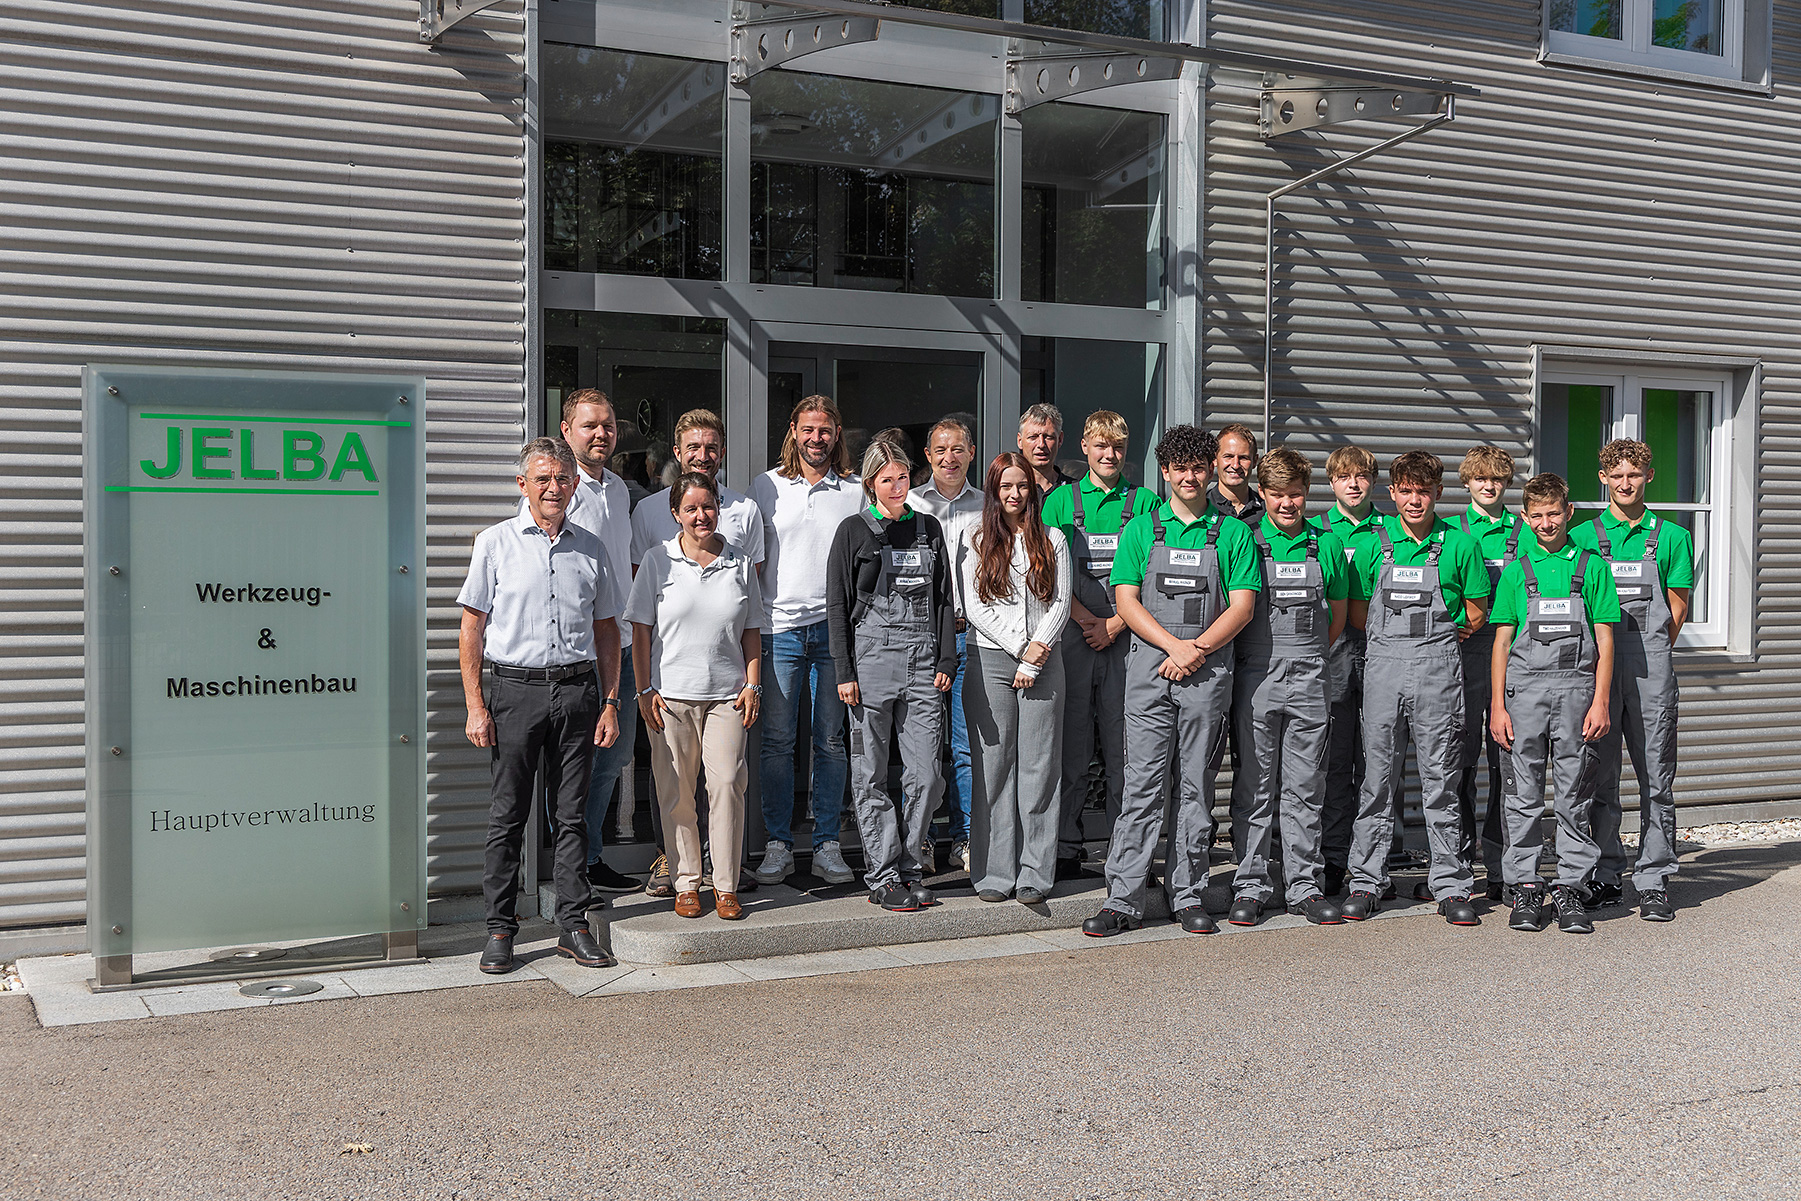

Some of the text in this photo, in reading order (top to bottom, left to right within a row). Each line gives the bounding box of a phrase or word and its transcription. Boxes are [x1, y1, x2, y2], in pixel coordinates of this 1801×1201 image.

[140, 426, 379, 482] JELBA
[196, 582, 331, 607] Werkzeug-
[257, 627, 277, 649] &
[166, 673, 357, 699] Maschinenbau
[150, 802, 376, 833] Hauptverwaltung
